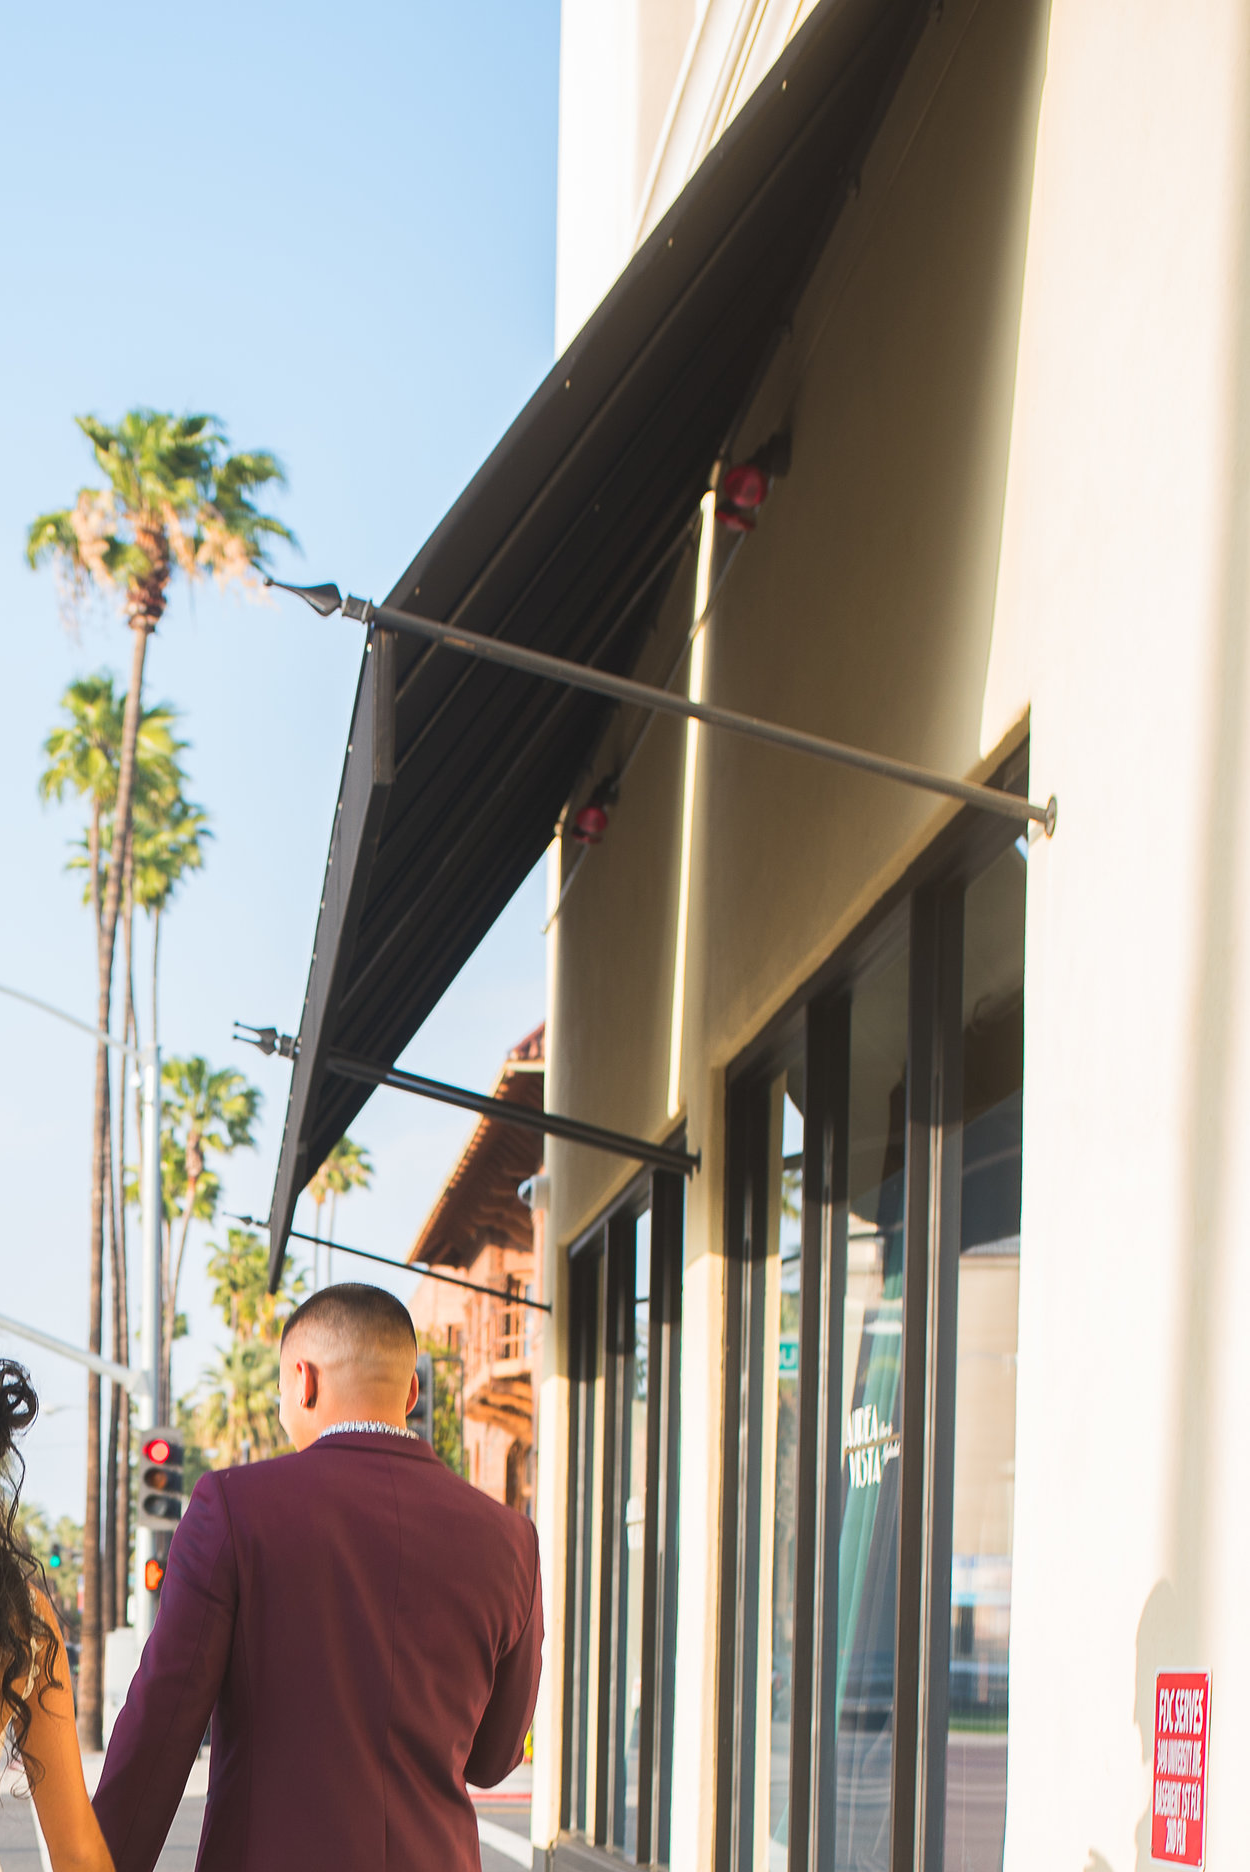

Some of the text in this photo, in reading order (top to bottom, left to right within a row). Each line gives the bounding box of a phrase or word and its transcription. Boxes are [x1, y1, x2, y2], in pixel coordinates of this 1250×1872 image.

[849, 1445, 882, 1489] VISTA
[1159, 1688, 1203, 1734] FDC SERVES
[1168, 1739, 1193, 1776] UNIVERSITY
[1181, 1782, 1191, 1820] 1ST
[1166, 1817, 1176, 1853] 2ND
